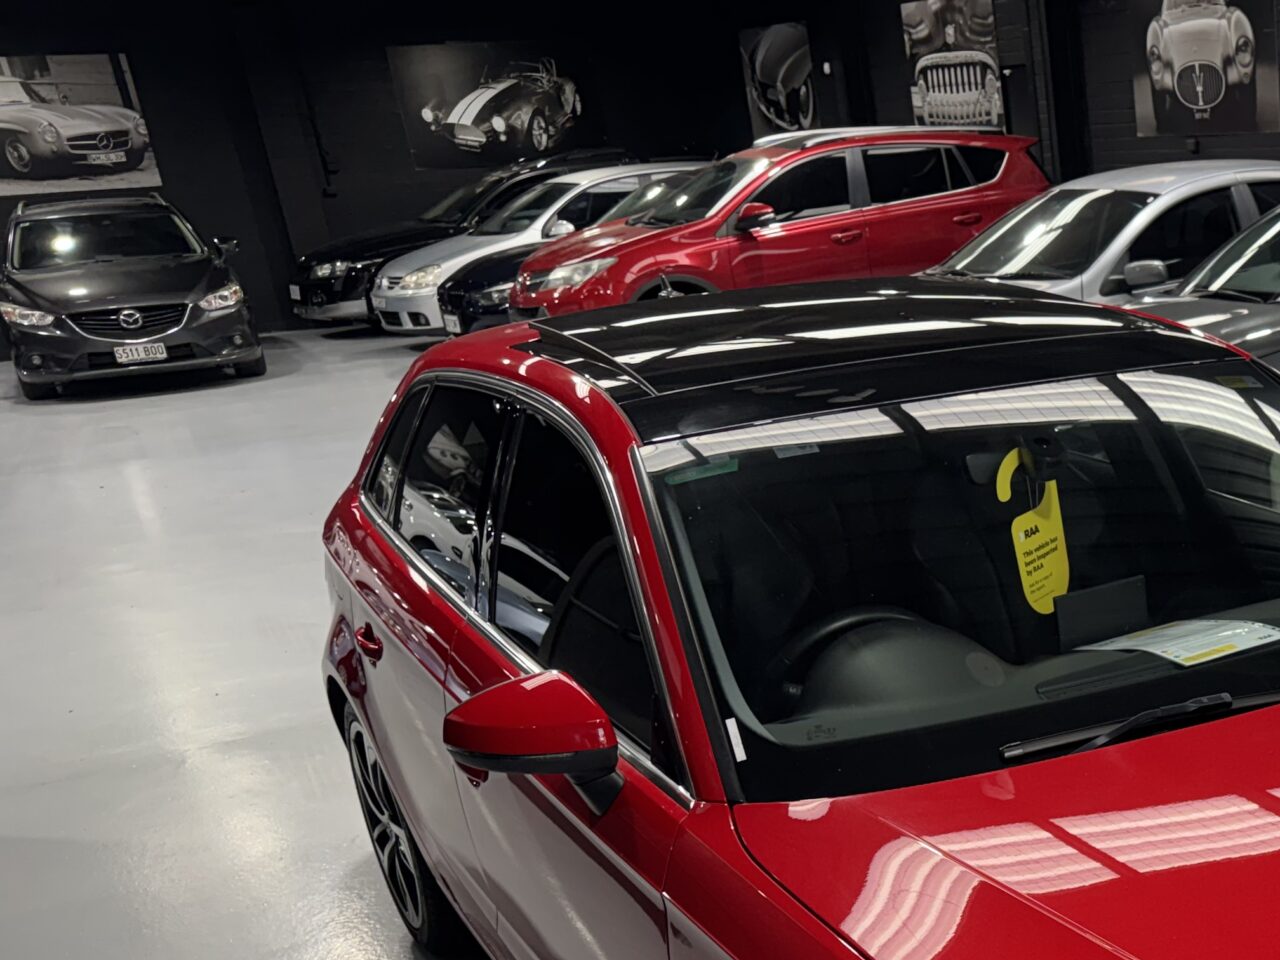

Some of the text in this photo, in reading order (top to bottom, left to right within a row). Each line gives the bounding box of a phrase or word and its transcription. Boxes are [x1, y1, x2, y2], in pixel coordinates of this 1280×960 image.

[115, 347, 140, 360] S511
[1024, 524, 1040, 540] RAA
[1023, 536, 1058, 558] This vehicle has
[1024, 544, 1058, 568] been inspected
[1026, 562, 1044, 577] by RAA
